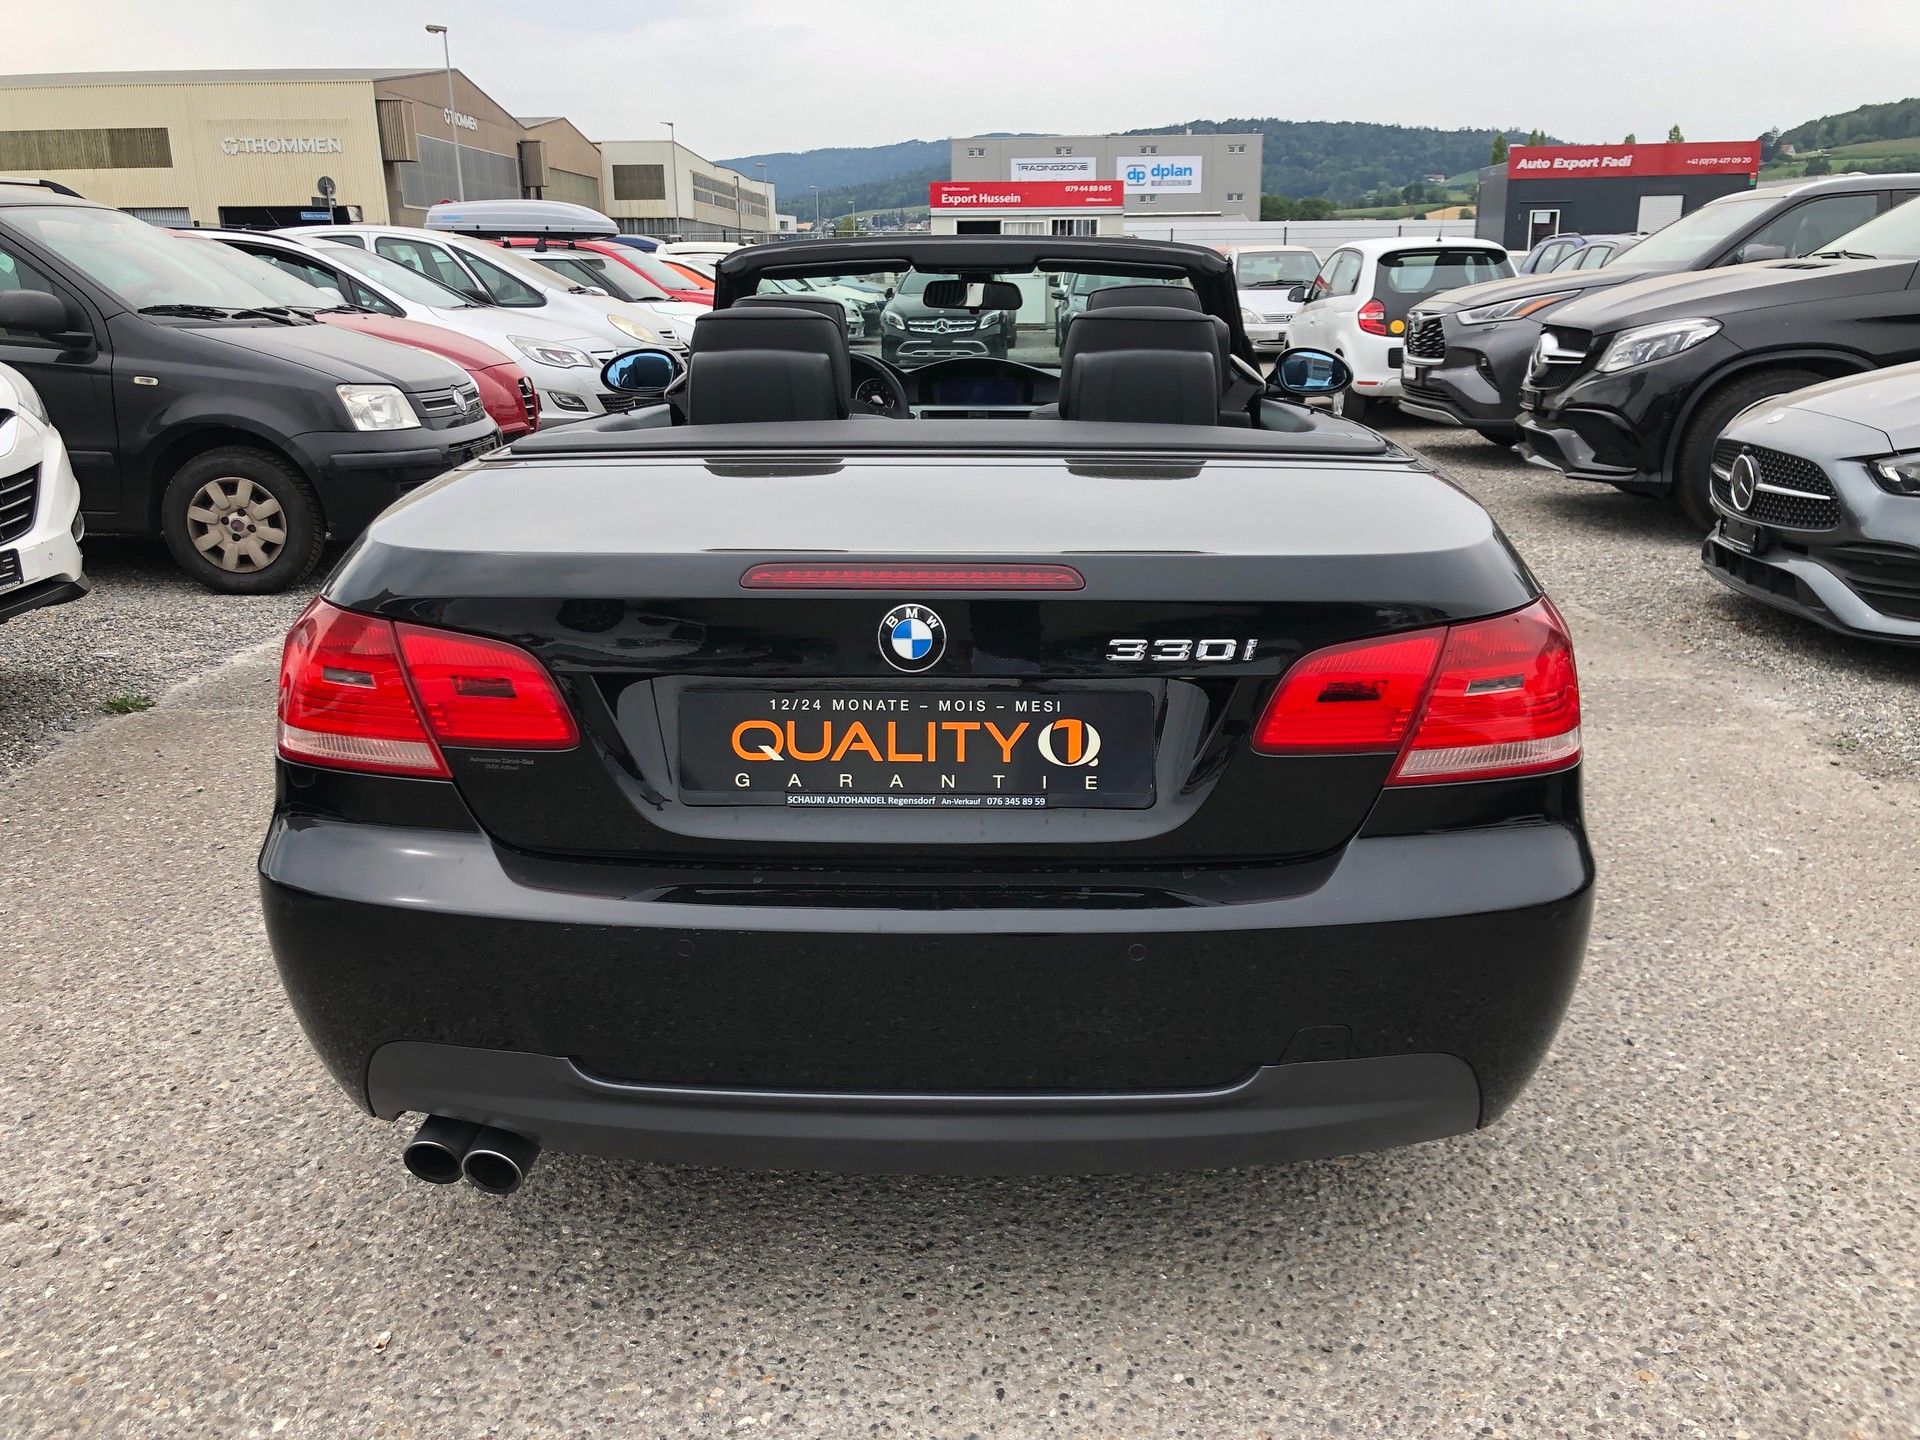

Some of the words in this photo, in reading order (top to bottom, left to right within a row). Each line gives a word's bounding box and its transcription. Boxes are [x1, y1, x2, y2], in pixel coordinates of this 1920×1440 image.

[240, 138, 342, 154] THOMMEN
[1516, 158, 1551, 169] Auto
[1553, 157, 1599, 170] Export
[1601, 155, 1633, 167] Fadi
[1742, 156, 1752, 164] 20
[1151, 164, 1193, 180] dplan
[941, 194, 978, 206] Export
[979, 193, 1021, 204] Hussein
[885, 608, 940, 629] BMW
[1105, 639, 1259, 661] 330i
[769, 699, 822, 711] 12/24
[832, 699, 910, 711] MONATE
[938, 700, 986, 712] MOIS
[1015, 701, 1061, 712] MESI
[731, 719, 1030, 763] QUALITY
[734, 772, 1098, 790] GARANTIE
[787, 795, 825, 804] SCHAUKI
[826, 796, 886, 805] AUTOHANDEL
[888, 796, 936, 806] Regensdorf
[941, 798, 981, 806] An-Verkauf
[986, 797, 1003, 806] 076
[1004, 797, 1020, 806] 345
[1022, 797, 1032, 806] 89
[1034, 797, 1046, 806] 59
